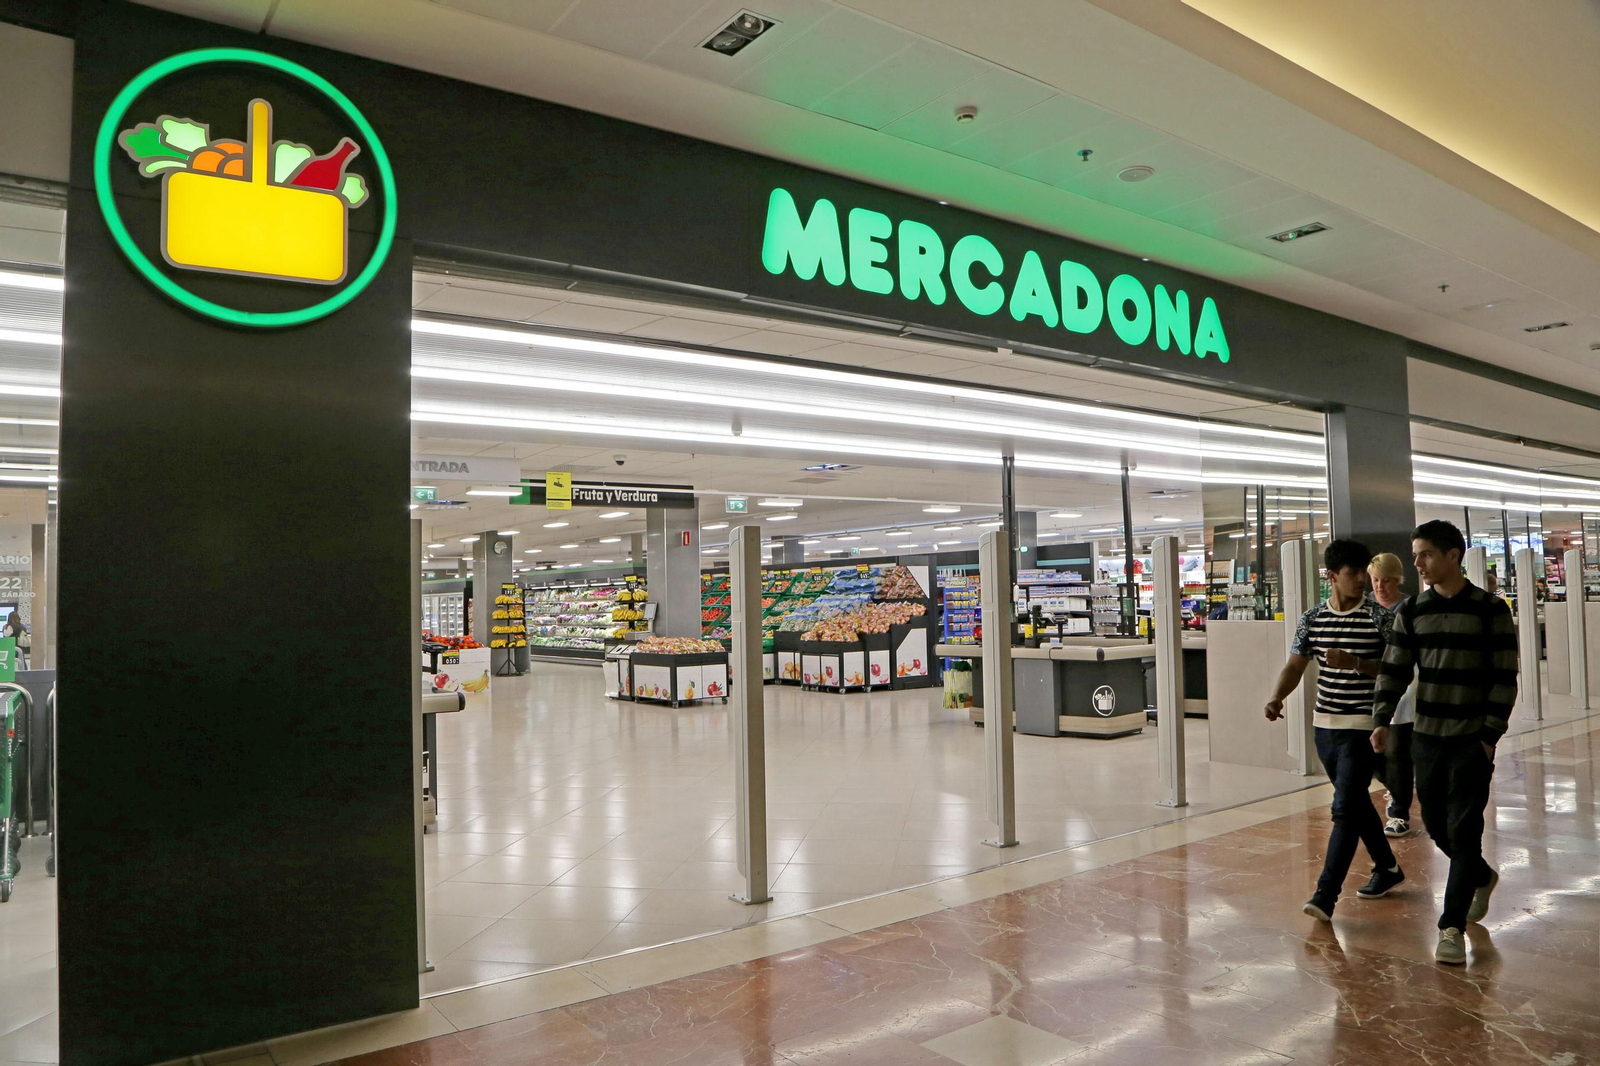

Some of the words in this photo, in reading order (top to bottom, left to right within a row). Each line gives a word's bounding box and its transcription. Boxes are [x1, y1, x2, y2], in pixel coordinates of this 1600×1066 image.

[762, 187, 1230, 364] MERCADONA
[572, 488, 604, 501] Fruta
[606, 491, 613, 503] y
[614, 489, 658, 503] Verdura
[1, 590, 36, 598] SÁBADO
